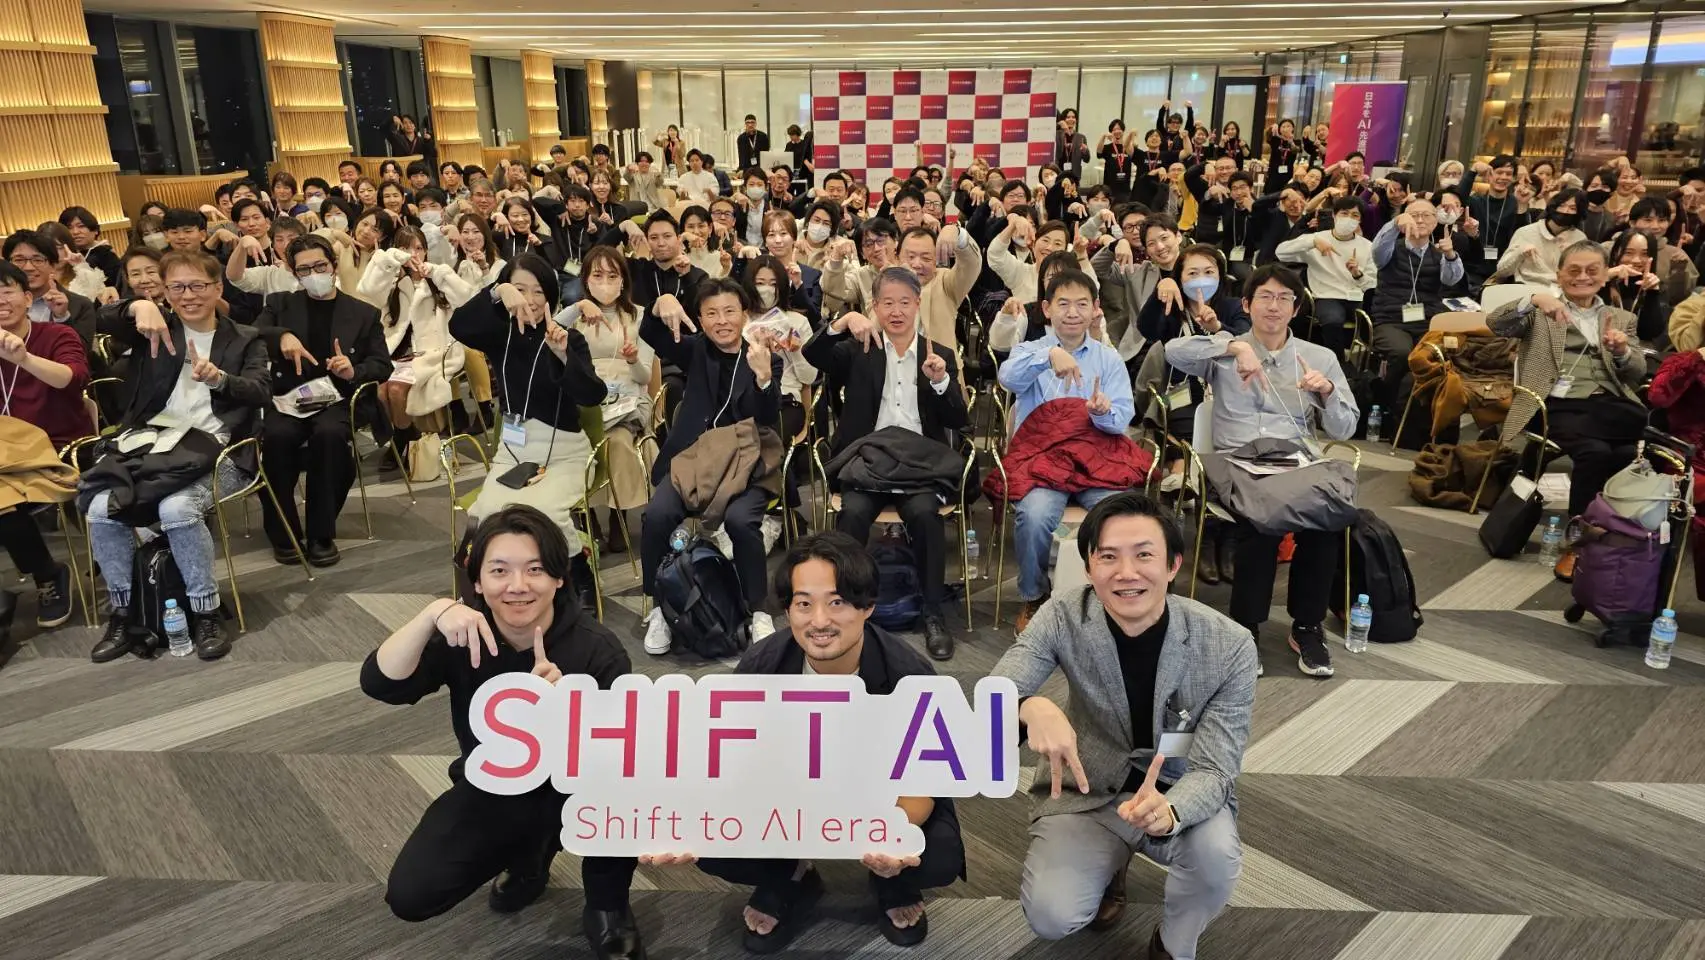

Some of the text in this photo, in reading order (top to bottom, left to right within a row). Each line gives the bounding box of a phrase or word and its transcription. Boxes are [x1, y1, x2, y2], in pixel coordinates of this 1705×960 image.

[479, 688, 1004, 782] SHIFT AI
[575, 805, 682, 841] Shift
[702, 812, 744, 842] to
[820, 816, 903, 844] era.
